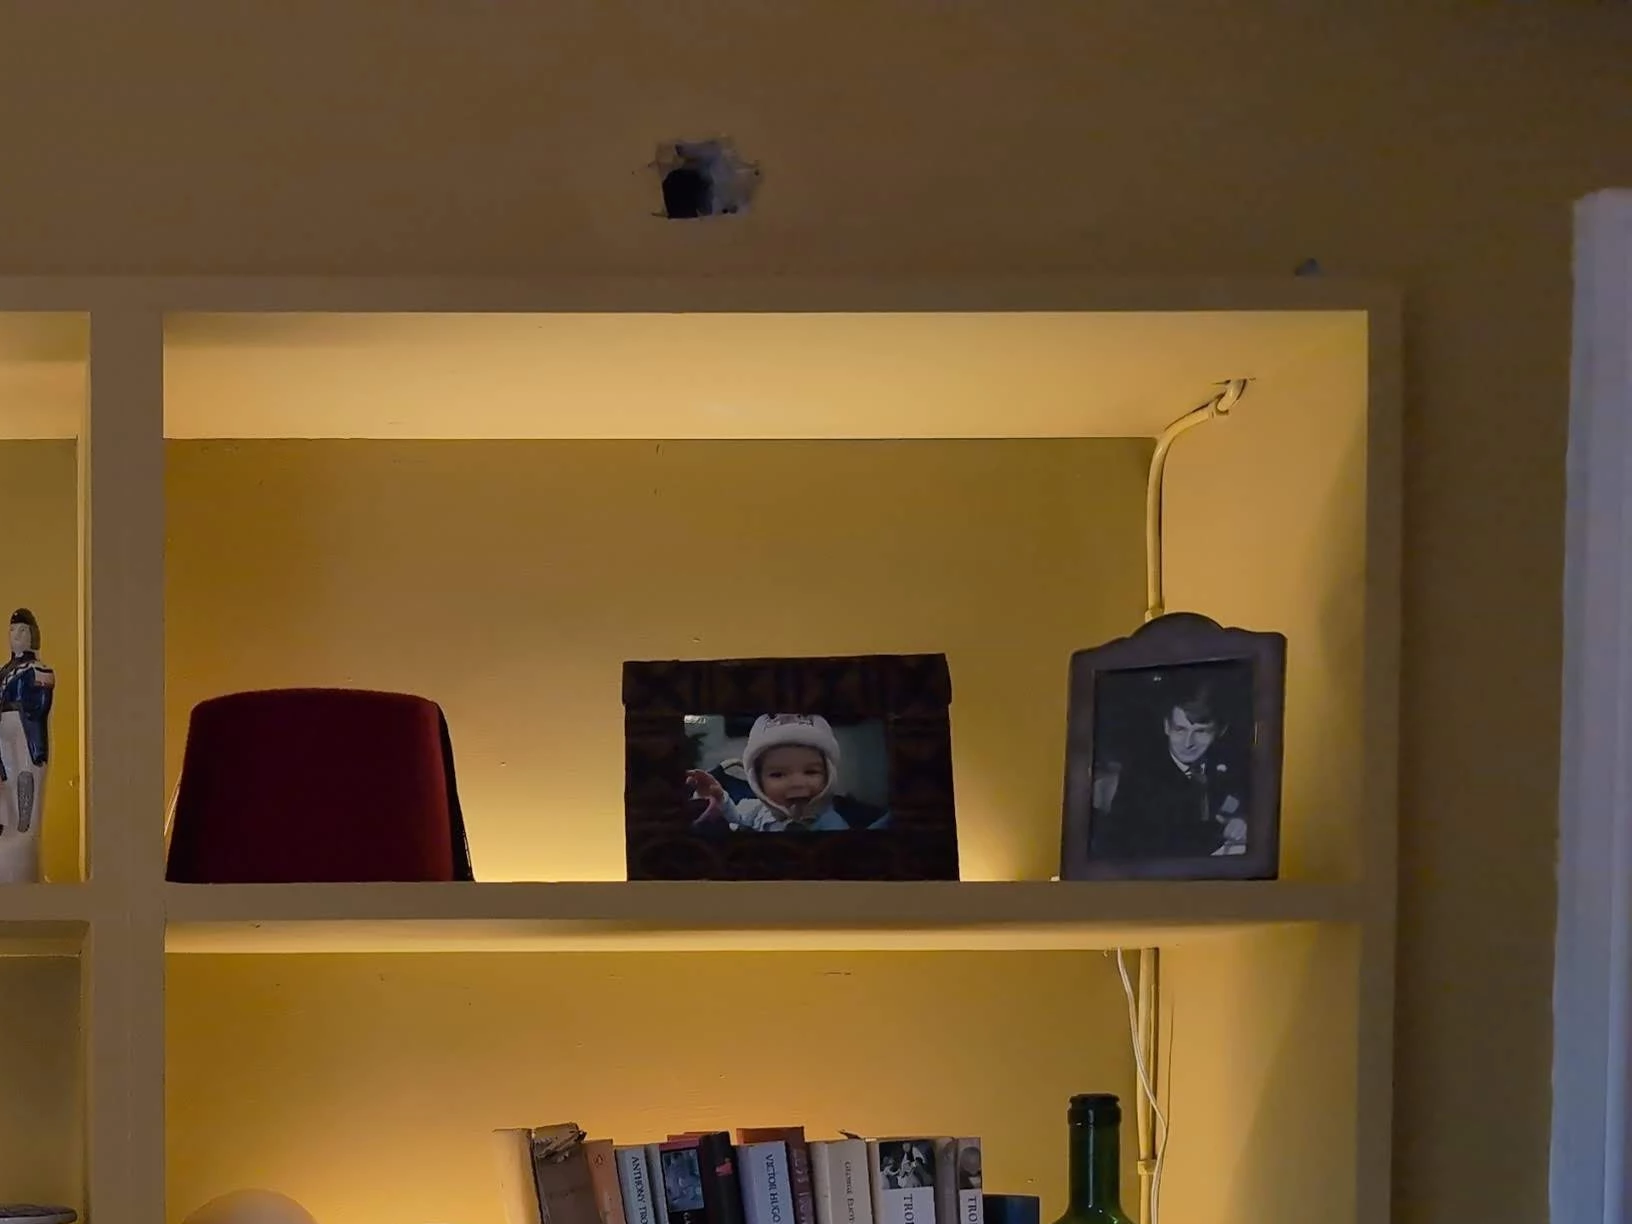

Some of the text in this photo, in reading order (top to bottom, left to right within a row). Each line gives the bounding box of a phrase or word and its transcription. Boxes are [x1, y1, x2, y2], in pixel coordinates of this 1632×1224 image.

[631, 1155, 646, 1204] ANTHONY
[765, 1154, 779, 1191] VICTOR
[770, 1192, 781, 1223] HUGO
